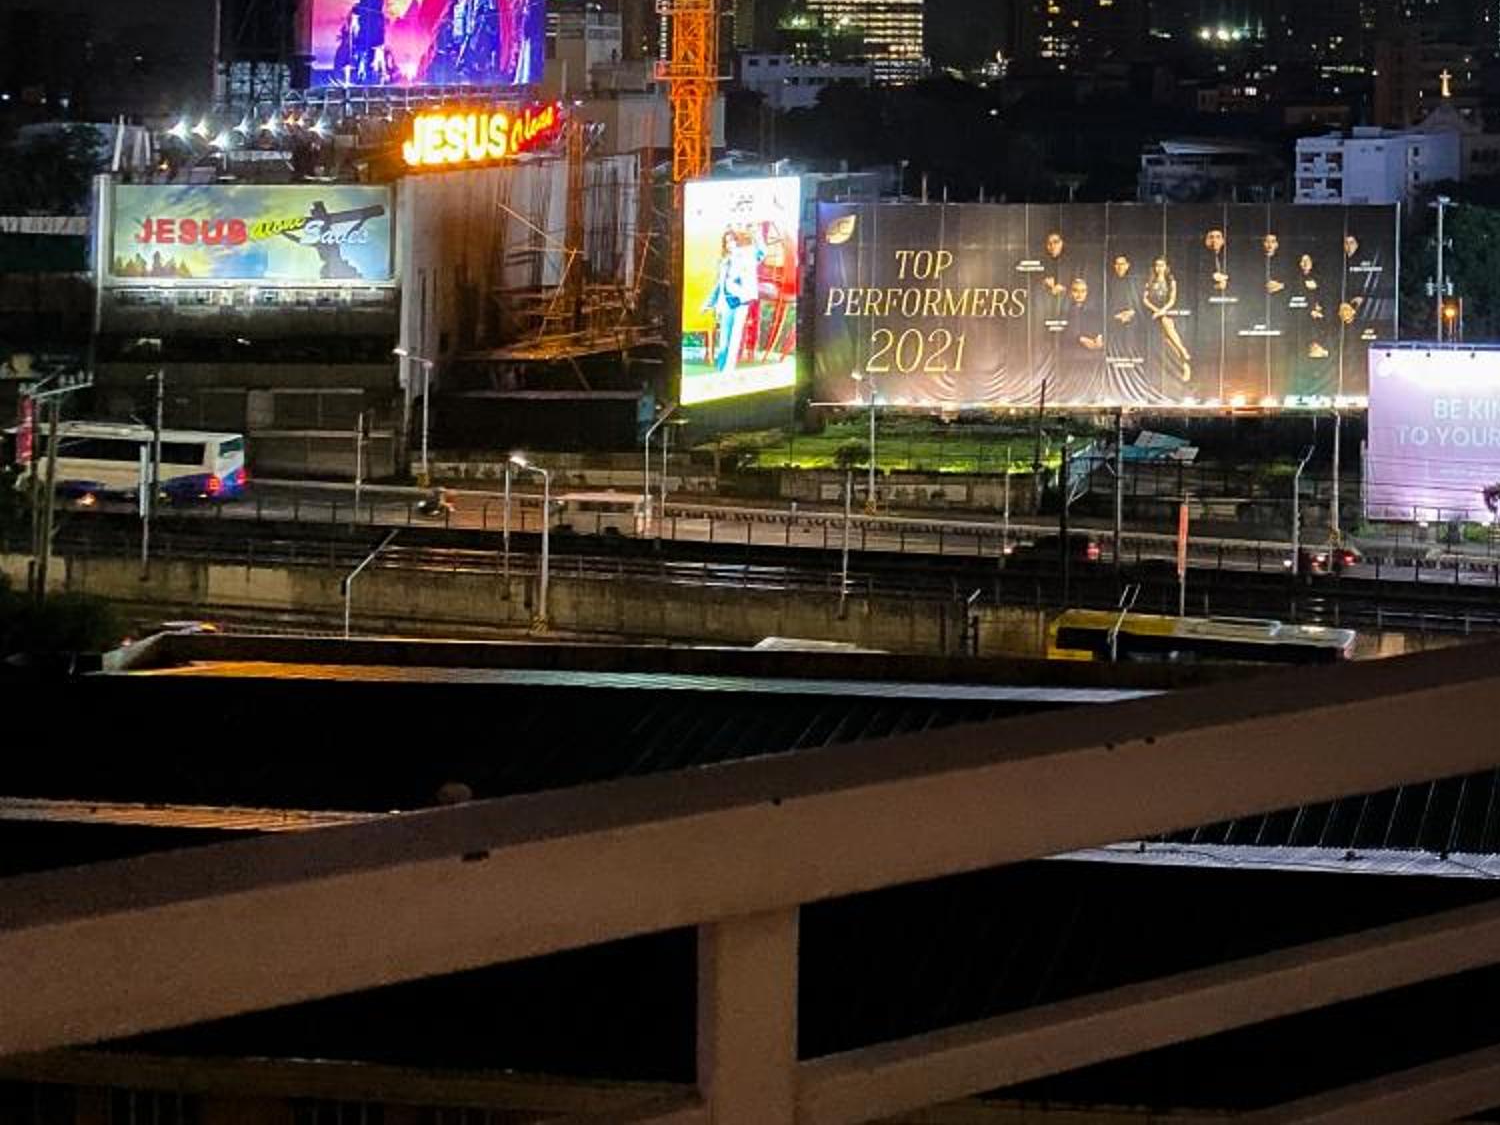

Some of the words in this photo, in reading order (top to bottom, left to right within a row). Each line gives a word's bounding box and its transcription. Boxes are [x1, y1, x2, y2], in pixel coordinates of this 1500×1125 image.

[403, 113, 508, 166] JESUS
[135, 218, 248, 245] JESUS
[895, 250, 953, 280] TOP
[824, 288, 1028, 318] PERFORMERS
[865, 328, 966, 374] 2021
[1433, 398, 1463, 419] BE
[1397, 426, 1429, 445] TO
